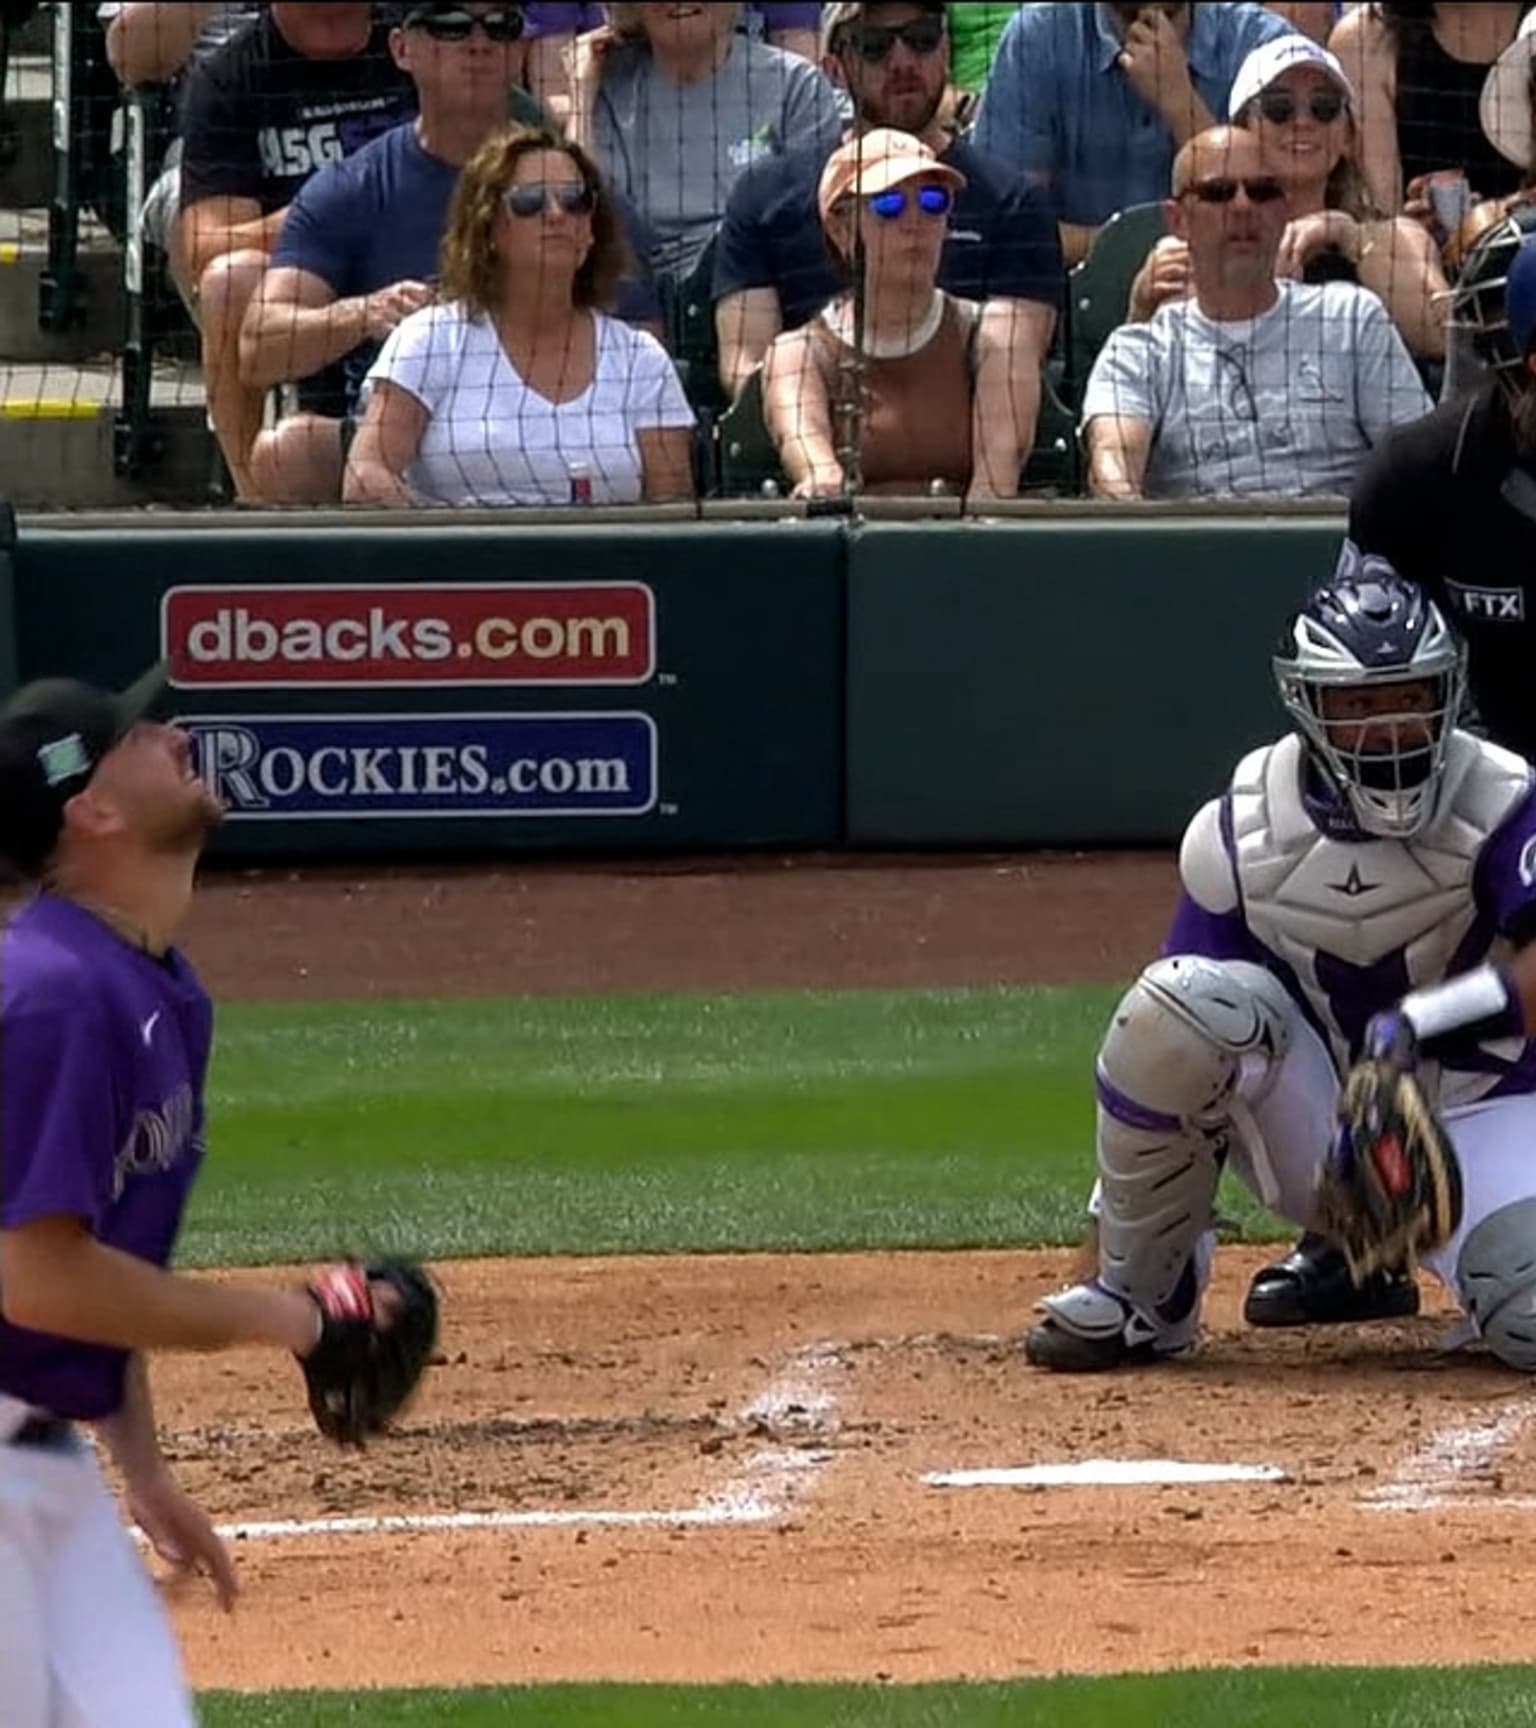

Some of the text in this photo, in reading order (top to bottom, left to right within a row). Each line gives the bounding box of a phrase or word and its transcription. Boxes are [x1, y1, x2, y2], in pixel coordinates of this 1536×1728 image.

[1464, 592, 1518, 615] FTX
[188, 608, 630, 661] dbacks.com
[192, 724, 630, 808] ROCKIES.com
